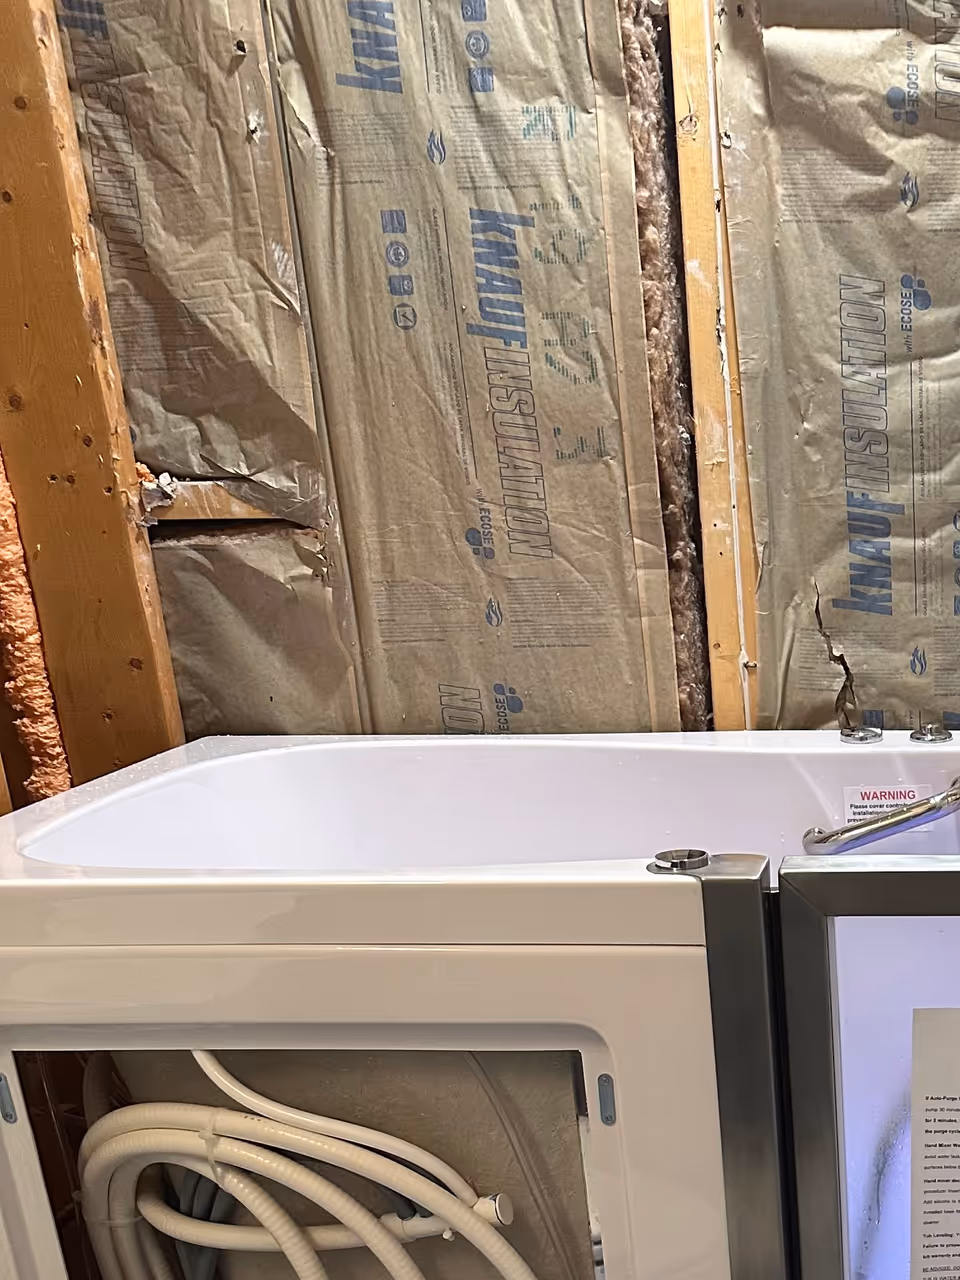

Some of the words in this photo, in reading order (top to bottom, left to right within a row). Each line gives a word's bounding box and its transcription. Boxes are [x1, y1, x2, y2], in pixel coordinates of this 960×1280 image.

[336, 0, 402, 94] KNA
[906, 64, 918, 108] ECOSE
[71, 38, 150, 272] INSULATION
[466, 207, 535, 349] KNAUF
[900, 292, 913, 332] ECOSE
[902, 334, 913, 353] with
[839, 274, 890, 492] INSULATION
[484, 346, 553, 559] INSULATION
[479, 508, 494, 545] ECOSE
[832, 491, 905, 616] KNAUF
[495, 697, 509, 731] ECOSE
[860, 790, 915, 800] WARNING
